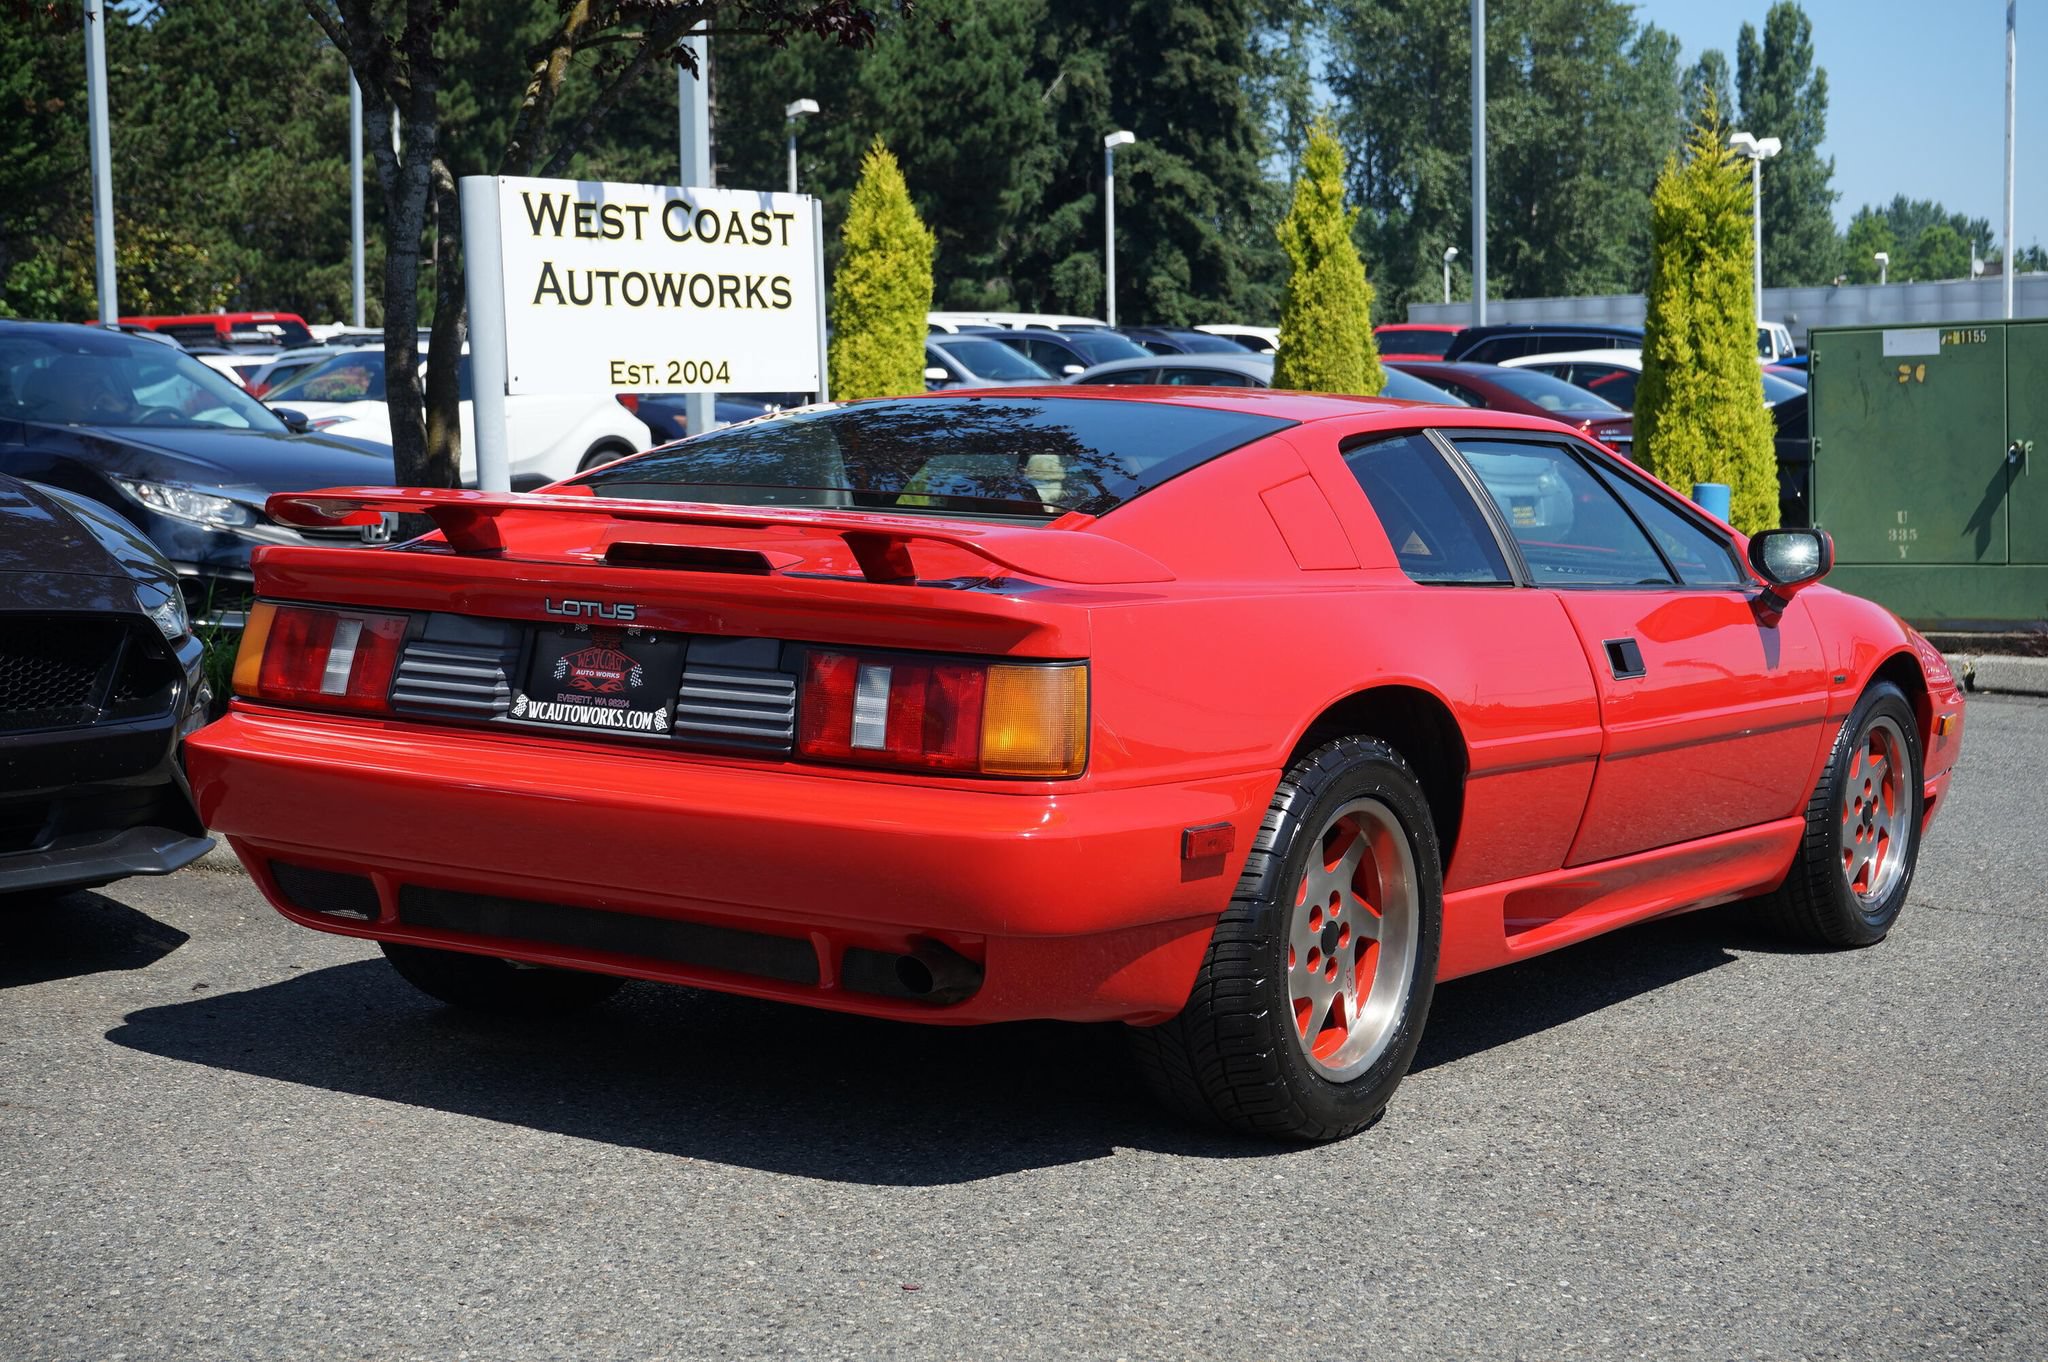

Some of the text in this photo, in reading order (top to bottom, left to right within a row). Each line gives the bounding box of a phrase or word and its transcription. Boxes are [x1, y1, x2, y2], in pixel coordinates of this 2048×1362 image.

[532, 261, 793, 310] AUTOWORKS
[667, 361, 731, 385] 2004
[545, 598, 636, 621] LOTUS
[576, 669, 621, 679] AUTO WORKS
[595, 696, 607, 706] WA
[528, 701, 653, 730] WCAUTOWORKS.COM
